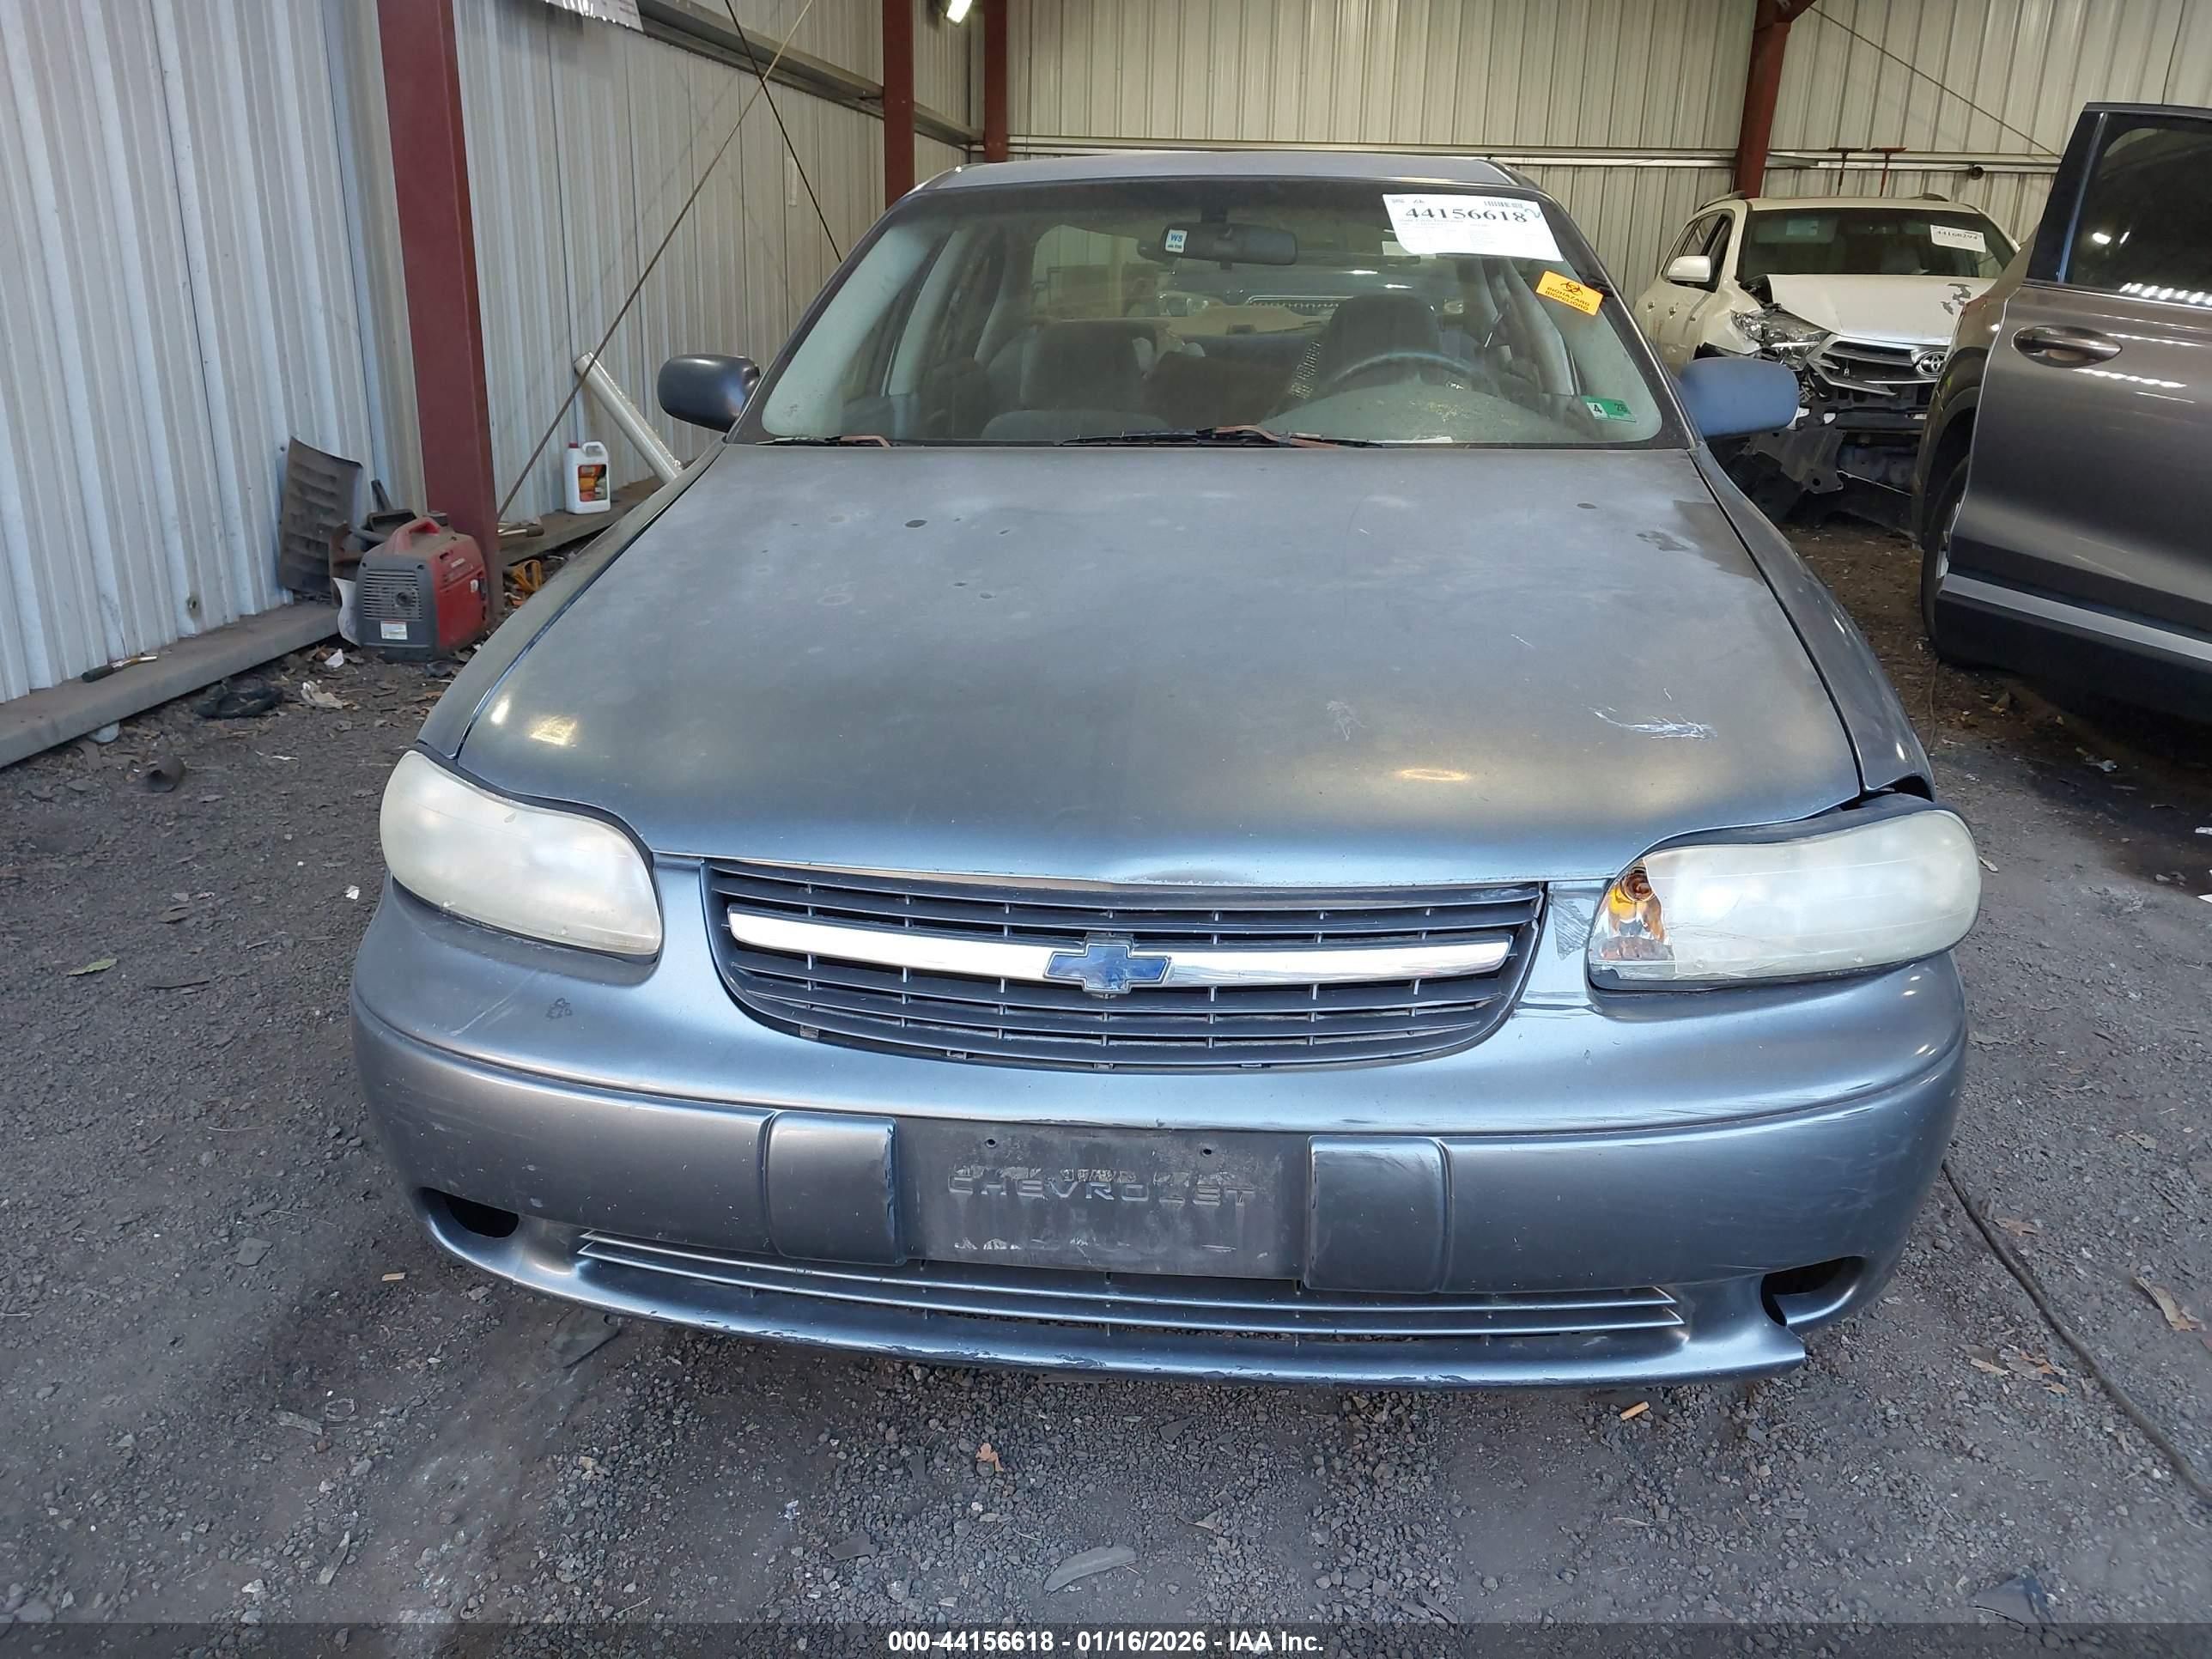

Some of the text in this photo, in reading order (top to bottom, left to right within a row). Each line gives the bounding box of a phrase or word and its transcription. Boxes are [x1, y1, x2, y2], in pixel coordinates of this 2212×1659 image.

[1405, 208, 1528, 223] 44156618
[1547, 286, 1590, 307] BIOHAZARD
[1593, 404, 1602, 414] 4
